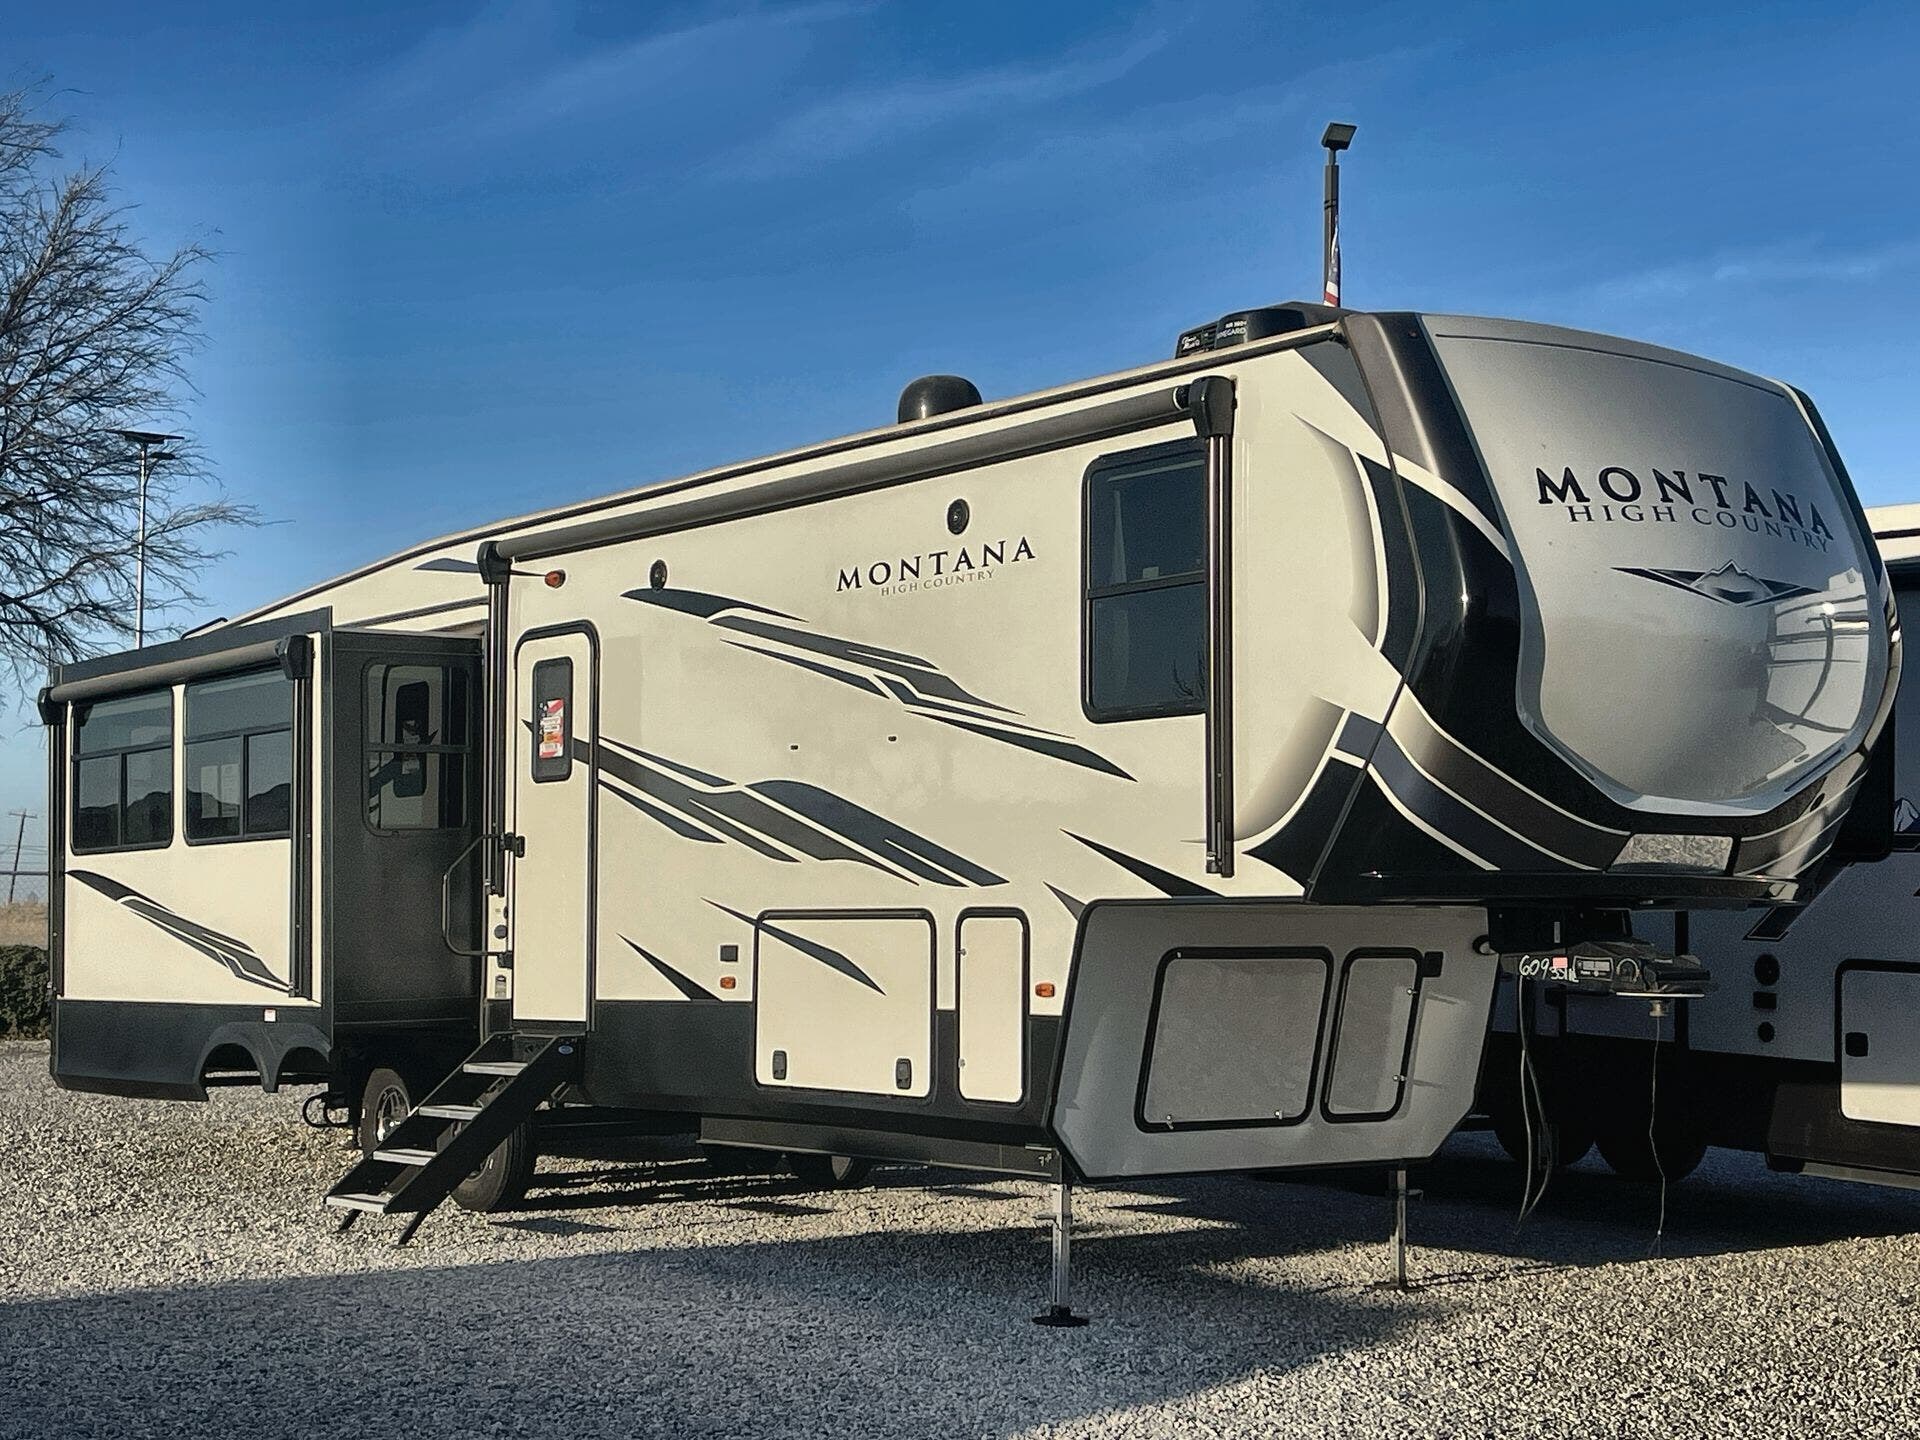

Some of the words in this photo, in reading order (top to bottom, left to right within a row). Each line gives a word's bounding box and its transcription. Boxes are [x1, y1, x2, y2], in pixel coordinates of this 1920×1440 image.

[1535, 466, 1834, 541] MONTANA
[1568, 504, 1678, 524] HIGH
[1691, 508, 1829, 553] COUNTRY
[836, 536, 1036, 592] MONTANA
[881, 582, 918, 597] HIGH
[923, 568, 996, 590] COUNTRY
[1519, 954, 1550, 980] 609
